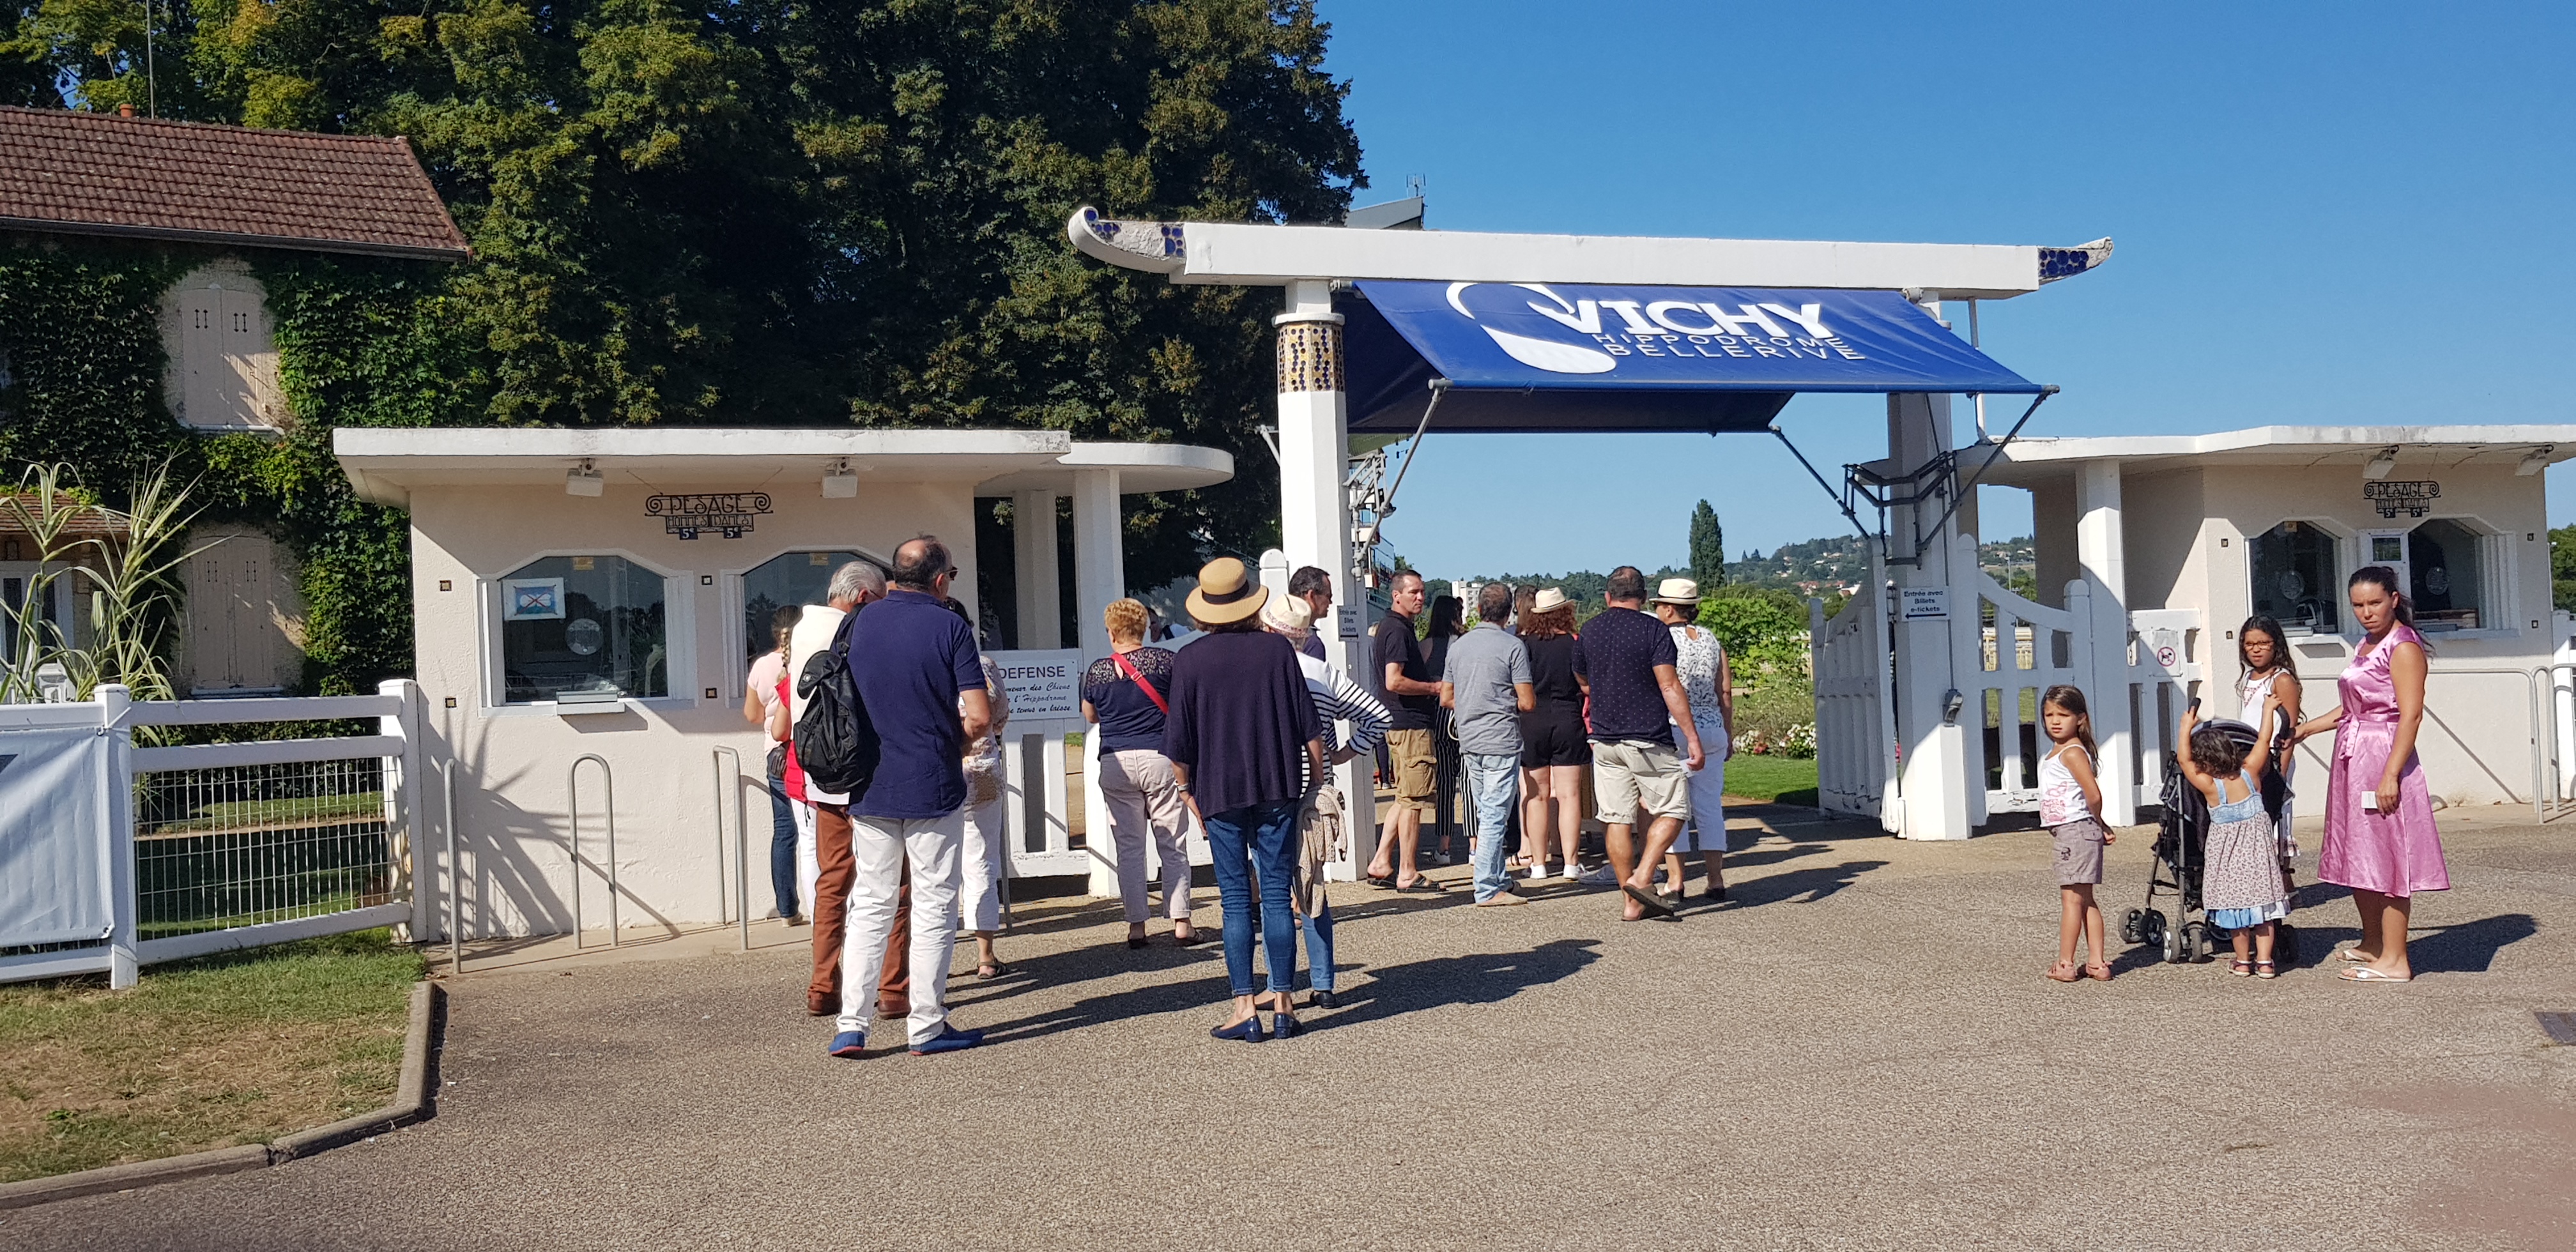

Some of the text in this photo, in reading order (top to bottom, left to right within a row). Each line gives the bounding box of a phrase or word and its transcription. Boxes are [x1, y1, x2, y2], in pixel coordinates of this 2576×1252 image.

[1528, 300, 1834, 339] VICHY
[1591, 333, 1848, 349] HIPPODROME
[1602, 343, 1867, 360] BELLERIVE
[2378, 482, 2425, 498] PESAGE
[670, 494, 746, 514] PESAGE
[668, 516, 707, 527] HOMMES
[715, 515, 749, 526] DAMES
[999, 666, 1066, 679] DEFENSE
[1030, 683, 1041, 692] des
[1046, 682, 1070, 692] Chiens
